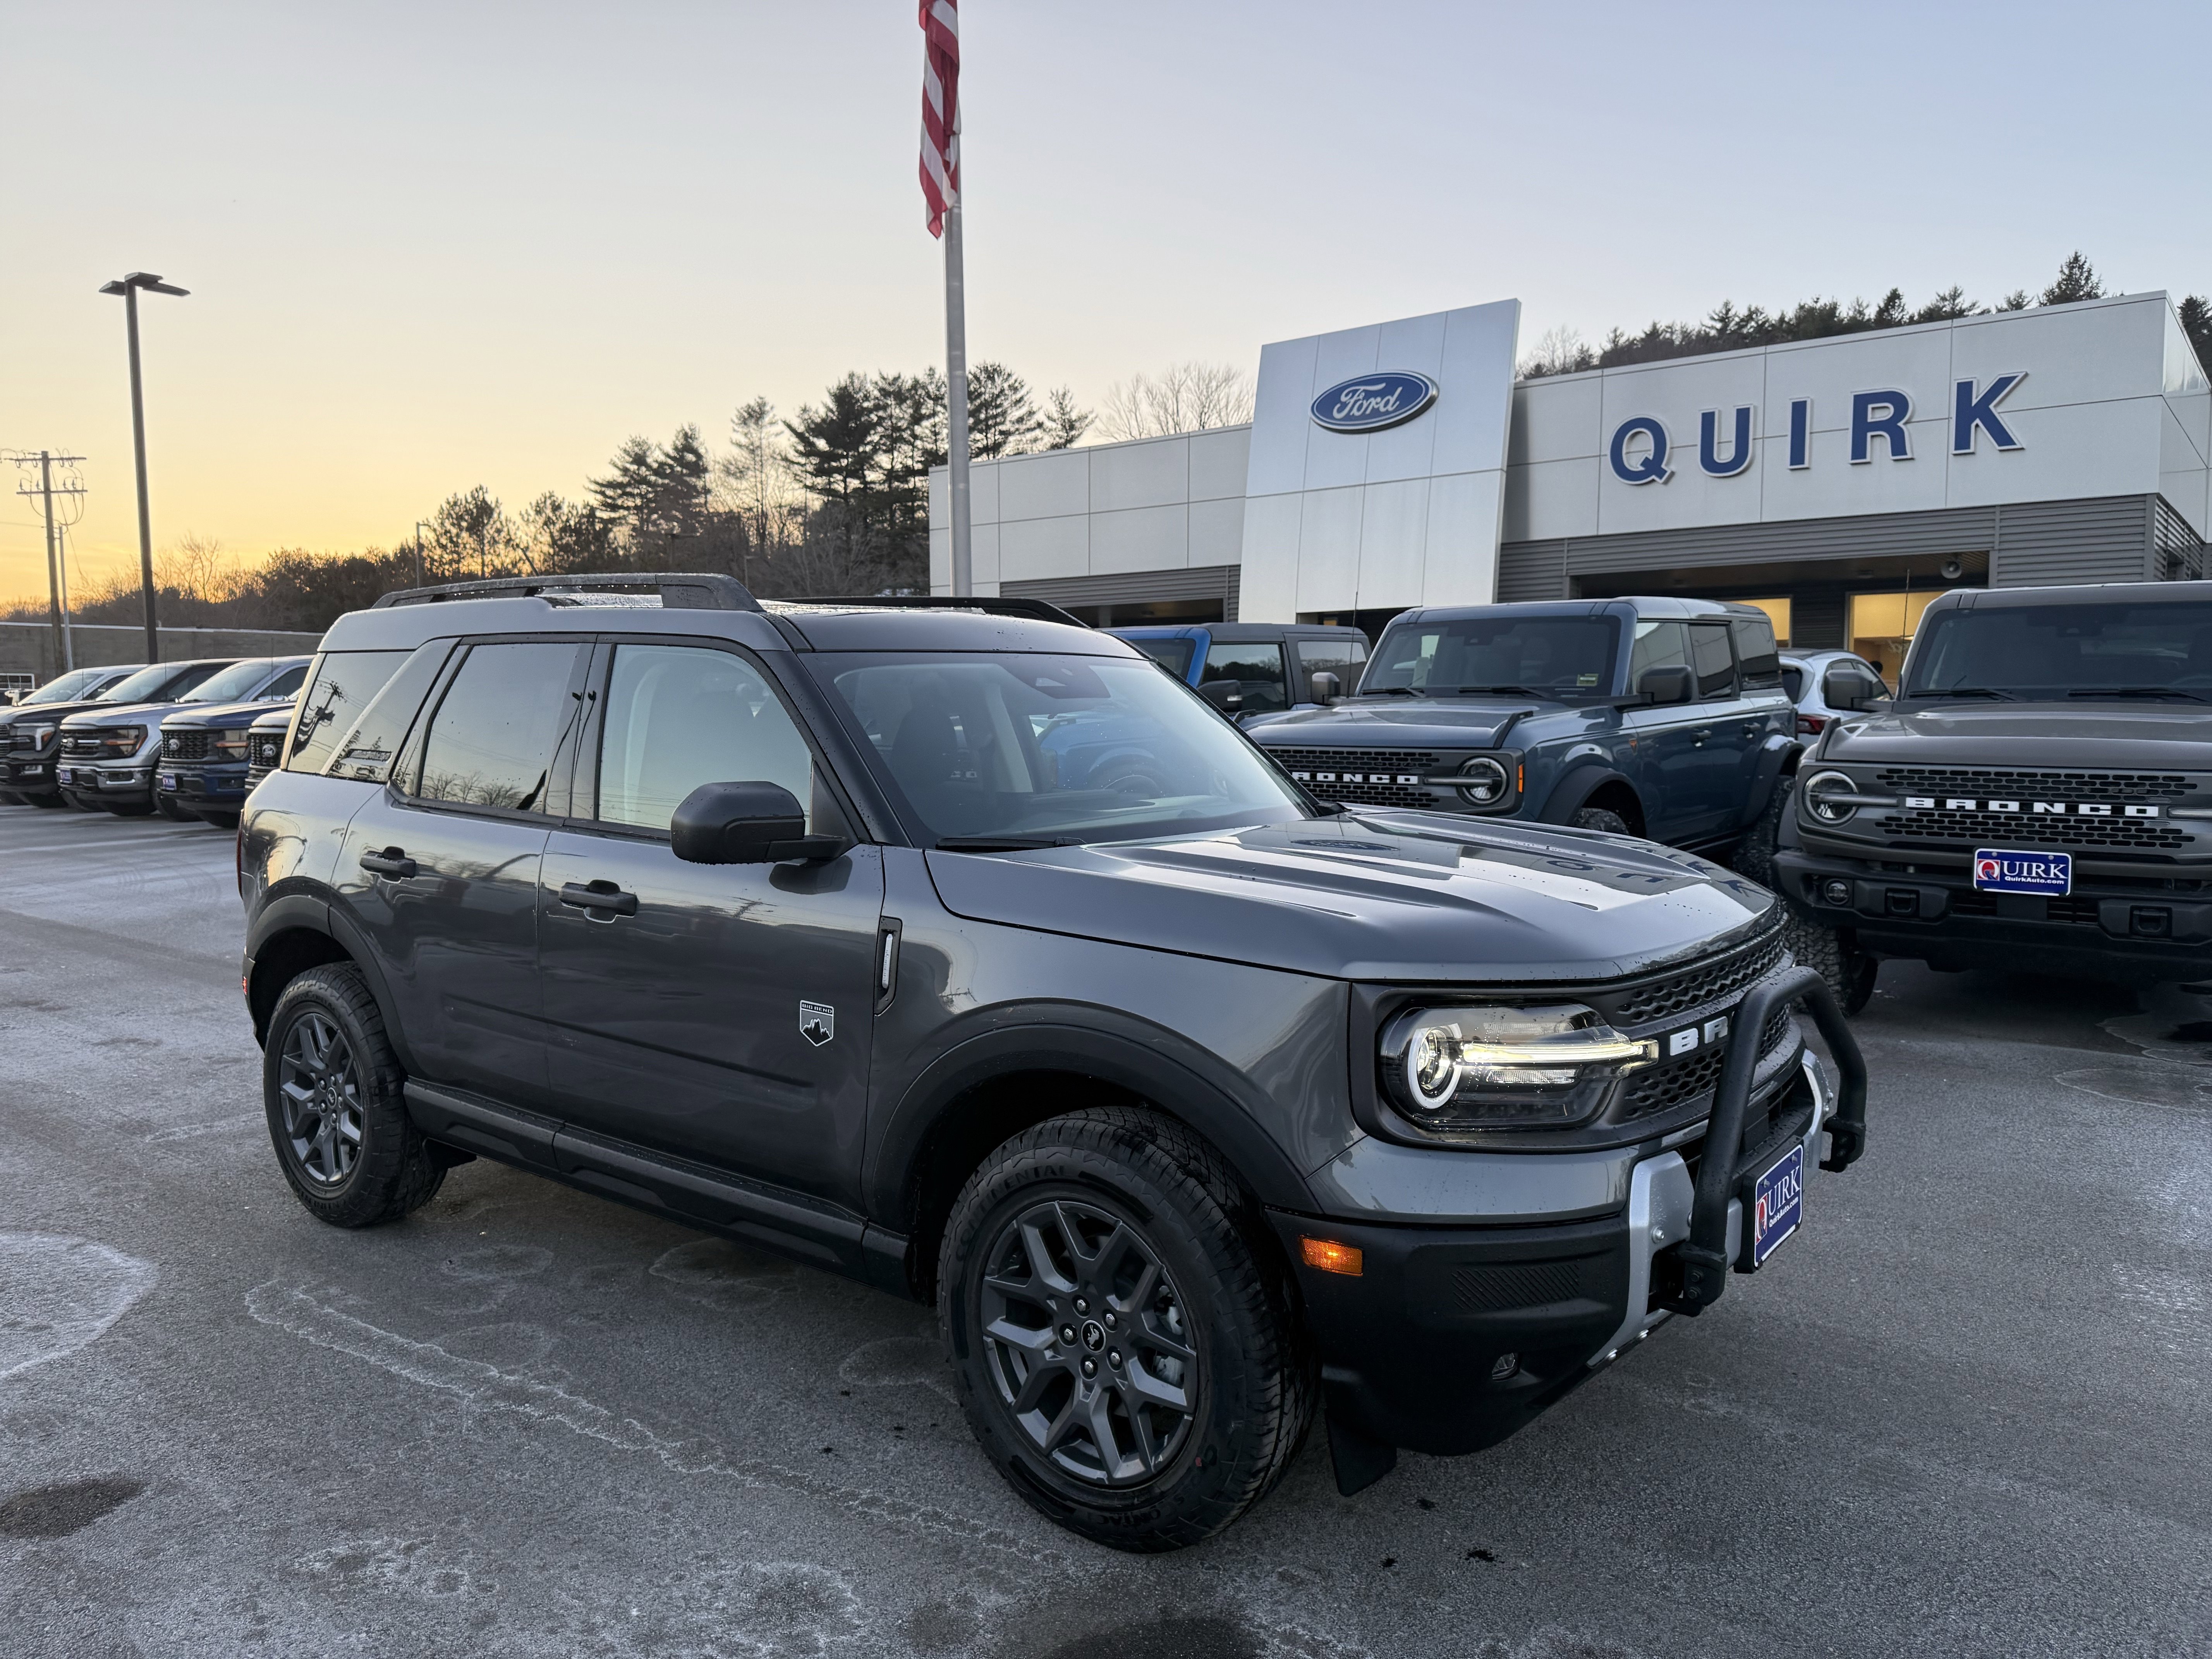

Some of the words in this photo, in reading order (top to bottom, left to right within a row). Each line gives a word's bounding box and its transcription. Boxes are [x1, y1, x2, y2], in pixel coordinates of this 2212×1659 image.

[1333, 383, 1402, 419] Ford
[1609, 371, 2027, 485] QUIRK
[1292, 772, 1418, 785] RONCO
[1906, 797, 2158, 817] BRONCO
[1978, 860, 2068, 880] QUIRK
[2005, 876, 2064, 884] QuirkAuto.com
[1670, 1016, 1728, 1056] BR
[1757, 1166, 1800, 1239] QUIRK
[1769, 1197, 1798, 1227] QuirkAuto.com
